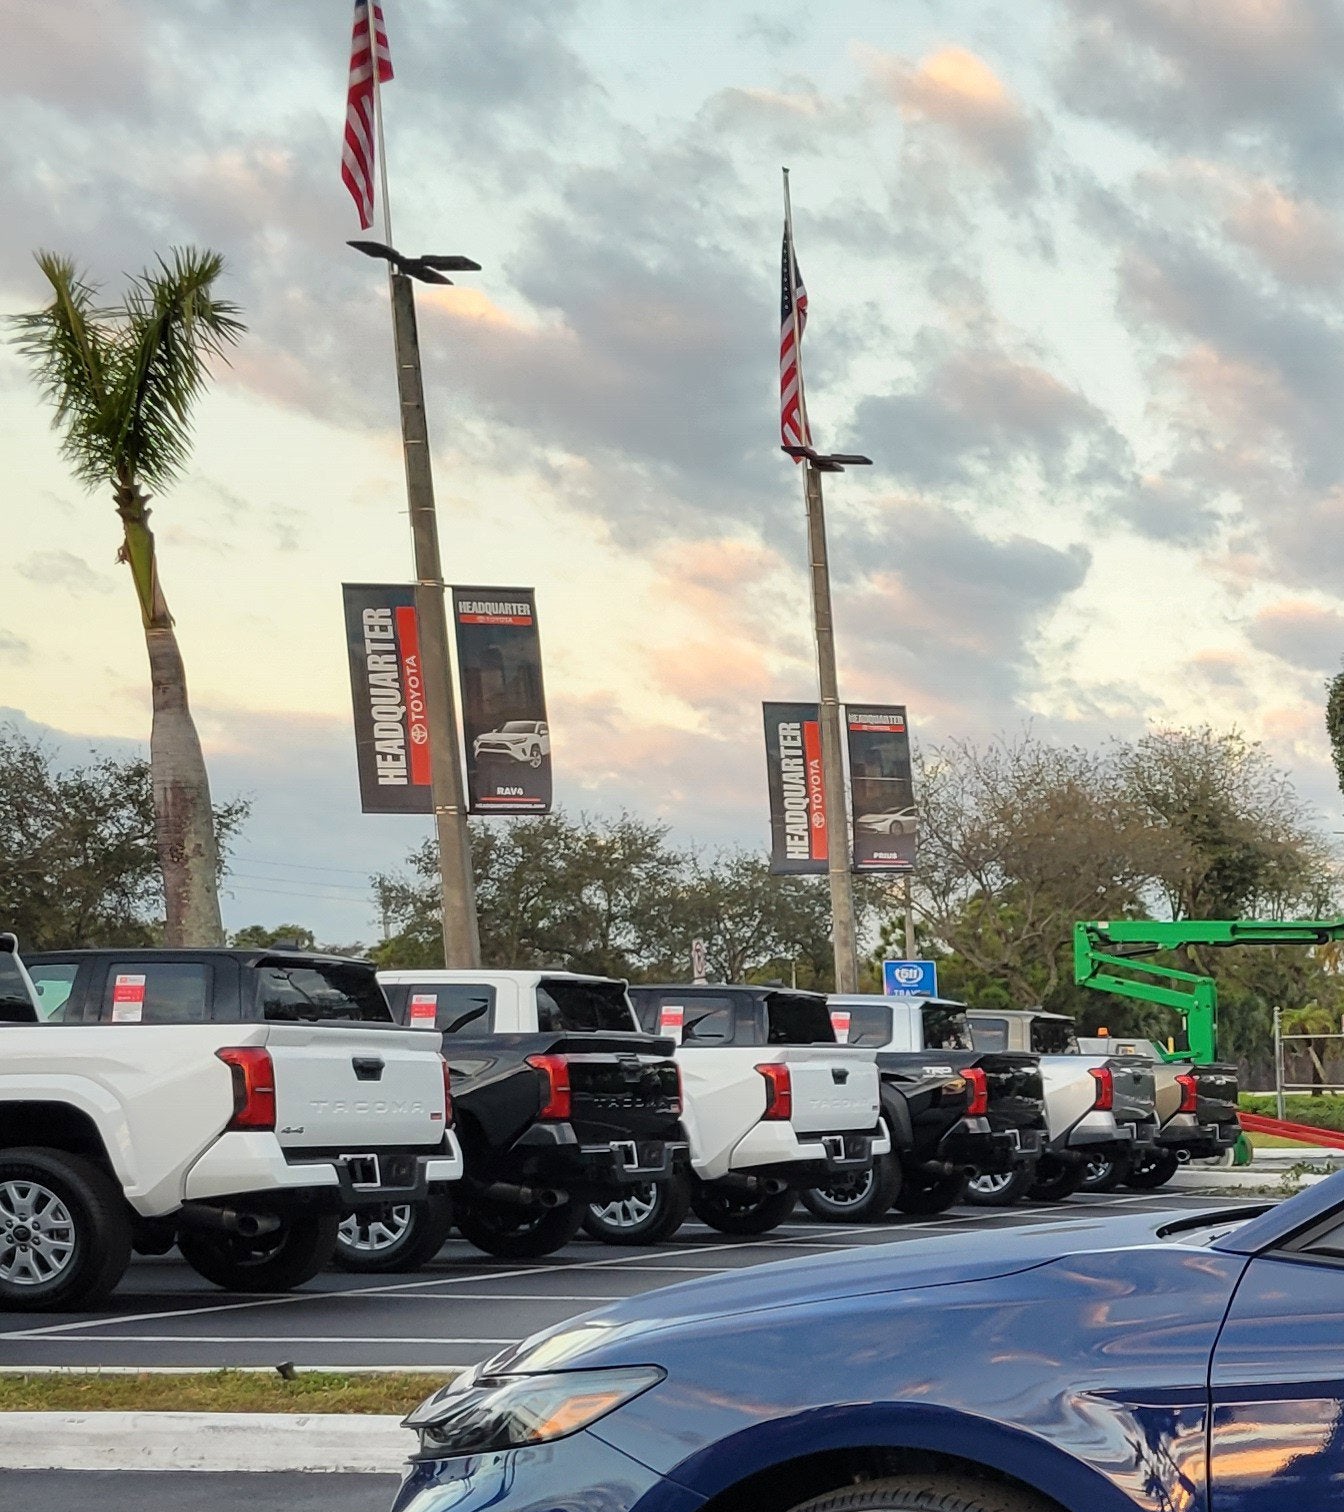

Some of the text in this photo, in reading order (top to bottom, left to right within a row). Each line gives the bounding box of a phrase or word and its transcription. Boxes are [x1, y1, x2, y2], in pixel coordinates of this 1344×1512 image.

[459, 601, 531, 615] HEADQUARTER
[362, 608, 408, 785] HEADQUARTER
[405, 655, 424, 722] TOYOTA
[496, 787, 524, 796] RAV4
[778, 722, 809, 860] HEADQUARTER
[810, 759, 823, 810] TOYOTA
[309, 1100, 424, 1114] TACOMA
